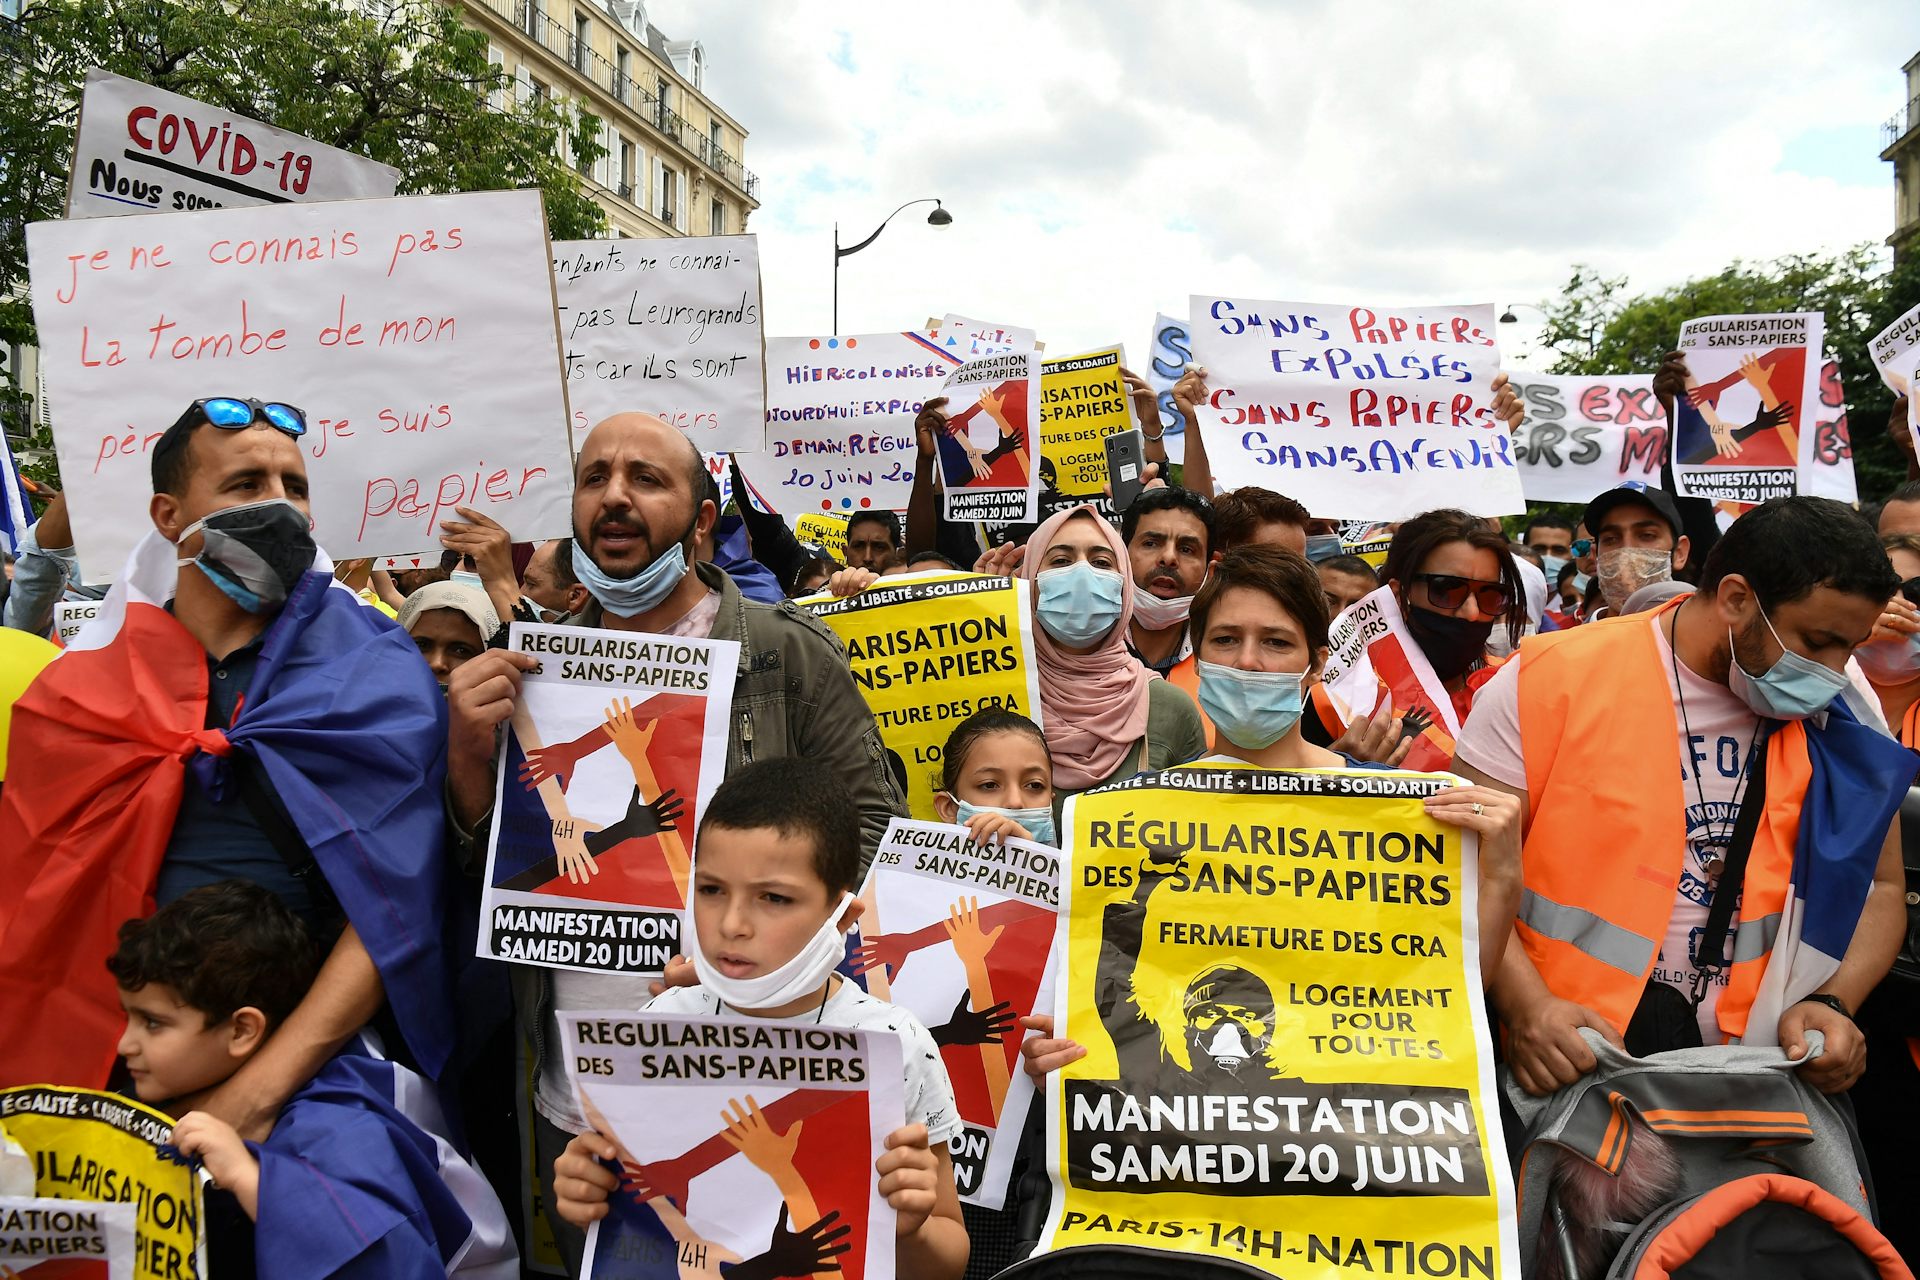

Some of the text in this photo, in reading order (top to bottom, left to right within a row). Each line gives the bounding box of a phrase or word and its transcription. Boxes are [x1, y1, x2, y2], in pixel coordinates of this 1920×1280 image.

[130, 244, 171, 270] ne
[209, 228, 359, 264] connais
[388, 227, 464, 276] pas
[637, 257, 657, 272] ne
[149, 300, 287, 361] tombe
[319, 294, 364, 347] de
[379, 313, 456, 345] mon
[570, 307, 615, 340] pas
[1211, 301, 1330, 340] SANS
[1681, 333, 1806, 348] DES SANS-PAPIERS
[596, 361, 633, 380] car
[691, 352, 747, 378] sont
[1066, 353, 1116, 371] SOLIDARITÉ
[1879, 348, 1896, 364] DES
[957, 368, 1028, 383] SANS-PAPIERS
[863, 399, 925, 415] EXPLO
[1211, 389, 1330, 427] SANS
[94, 425, 164, 473] pèr
[378, 403, 453, 433] suis
[1041, 430, 1071, 445] TURE
[1074, 430, 1096, 441] DES
[1060, 451, 1105, 465] LOGEM
[1080, 464, 1108, 473] POU
[782, 469, 814, 486] 20
[881, 462, 914, 482] 20
[1682, 472, 1795, 486] MANIFESTATION
[357, 460, 548, 541] papier
[950, 491, 1026, 507] MANIFESTATION
[1742, 488, 1757, 499] 20
[1760, 487, 1791, 500] JUIN
[953, 506, 1023, 519] SAMEDI 20 JUIN
[798, 534, 810, 542] DES
[801, 521, 847, 540] RÉGULAR
[1363, 543, 1390, 552] ÉGALIT
[860, 586, 913, 607] LIBERTÉ
[926, 577, 1010, 597] SOLIDARITÉ
[561, 661, 709, 690] SANS-PAPIERS
[1325, 667, 1340, 684] DES
[877, 705, 932, 730] TURE
[937, 700, 972, 720] DES
[1160, 771, 1233, 790] ÉGALITÉ
[1252, 772, 1322, 793] LIBERTÉ
[1090, 811, 1444, 864] RÉGULARISATION
[879, 852, 902, 865] DES
[1084, 861, 1451, 906] DES SANS-PAPIERS
[495, 909, 678, 940] MANIFESTATION
[1160, 922, 1447, 958] FERMETURE DES CRA
[500, 936, 671, 969] SAMEDI 20 JUIN
[1290, 983, 1452, 1009] LOGEMENT
[1332, 1013, 1416, 1032] POUR
[577, 1055, 865, 1082] DES SANS-PAPIERS
[2, 1093, 78, 1114] ÉGALITÉ
[1073, 1093, 1470, 1135] MANIFESTATION
[1090, 1142, 1464, 1190] SAMEDI 20 JUIN
[0, 1209, 97, 1232] ATION
